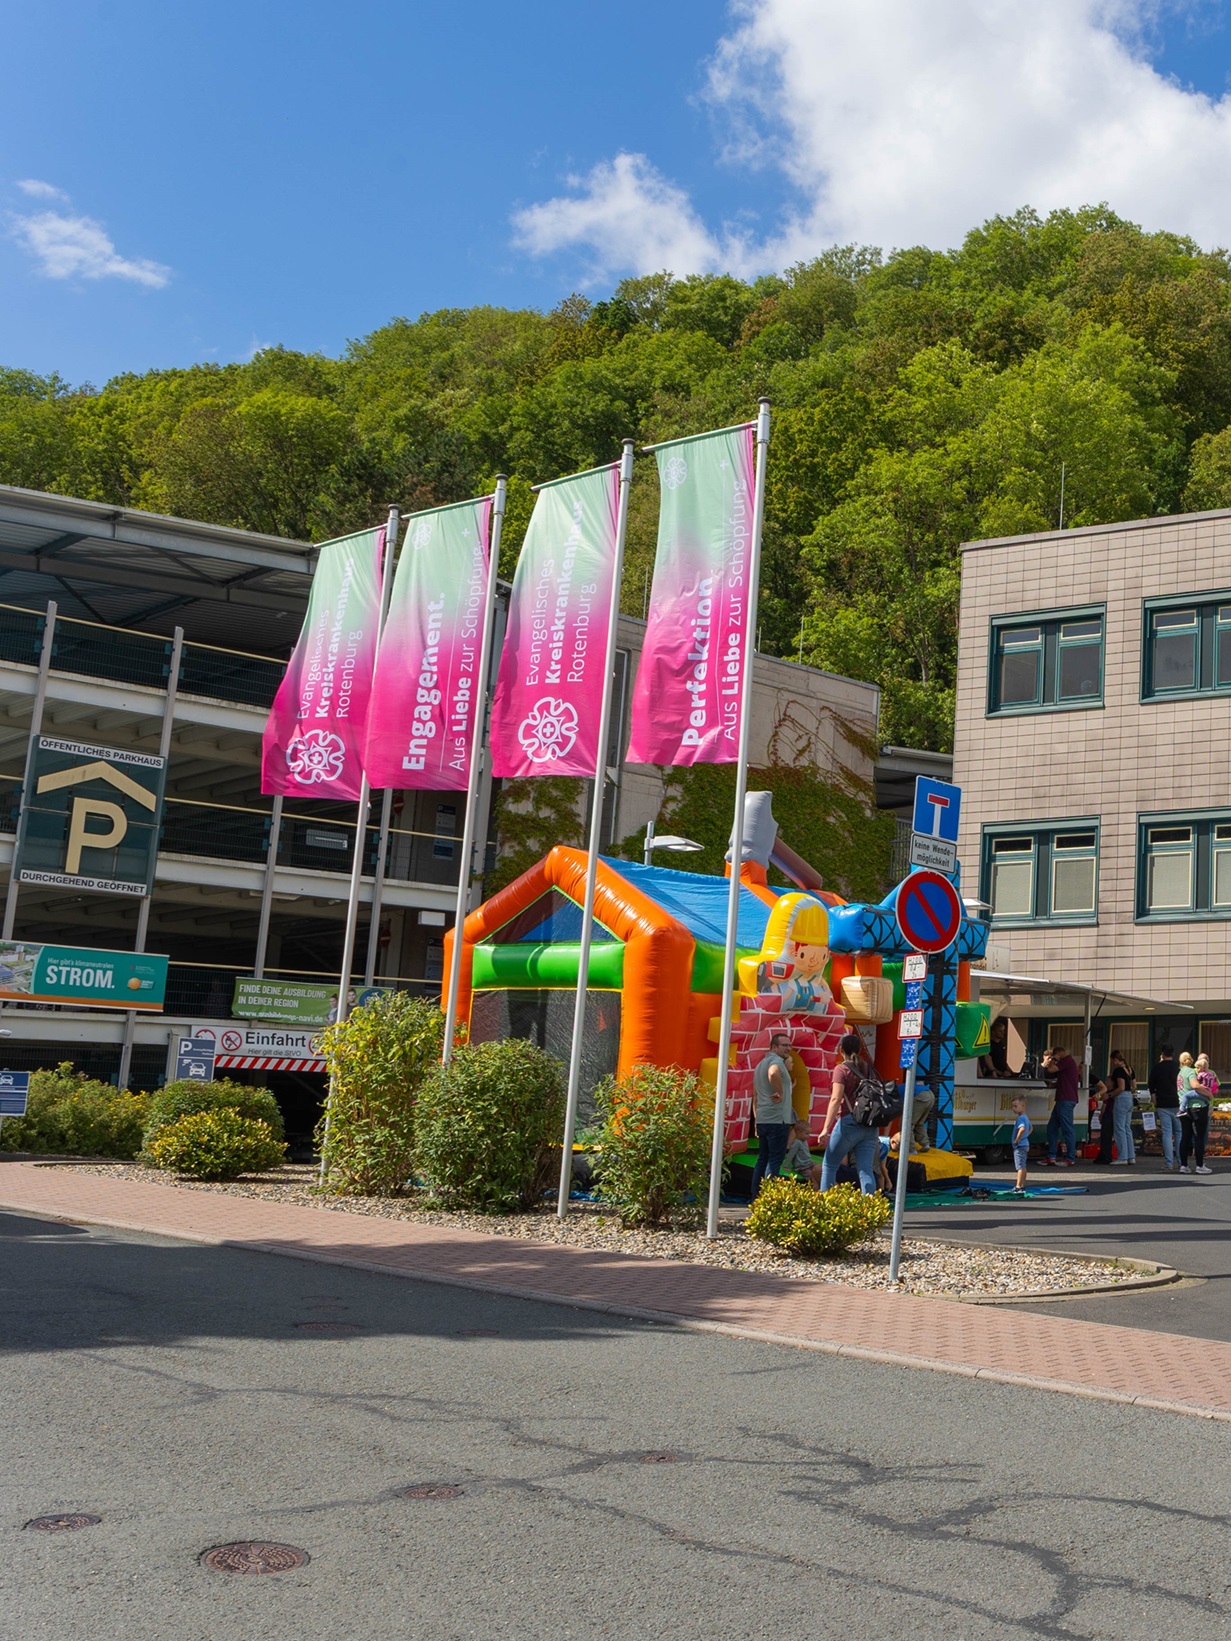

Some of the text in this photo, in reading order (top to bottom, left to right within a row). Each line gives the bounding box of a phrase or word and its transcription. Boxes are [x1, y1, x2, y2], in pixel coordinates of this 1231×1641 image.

[545, 501, 584, 684] Kreiskrankenhaus
[526, 559, 554, 686] Evangelisches
[729, 596, 742, 625] zur
[315, 558, 354, 717] Kreiskrankenhaus
[567, 583, 597, 682] Rotenburg
[297, 609, 330, 719] Evangelisches
[336, 630, 363, 717] Rotenburg
[461, 644, 474, 672] zur
[722, 633, 740, 695] Liebe
[402, 592, 445, 770] Engagement.
[451, 677, 471, 731] Liebe
[724, 701, 738, 740] Aus
[41, 737, 162, 766] ÖFFENTLICHES PARKHAUS
[449, 737, 466, 771] Aus
[65, 797, 128, 874] P
[915, 840, 953, 856] keine Wende-
[916, 853, 950, 867] möglichkeit
[21, 872, 145, 893] DURCHGEHEND GEÖFFNET
[45, 965, 115, 989] STROM.
[239, 984, 326, 999] FINDE DEINE AUSBILDUNG
[238, 996, 299, 1008] IN DEINER REGION
[180, 1041, 193, 1054] P
[245, 1031, 306, 1047] Einfahrt
